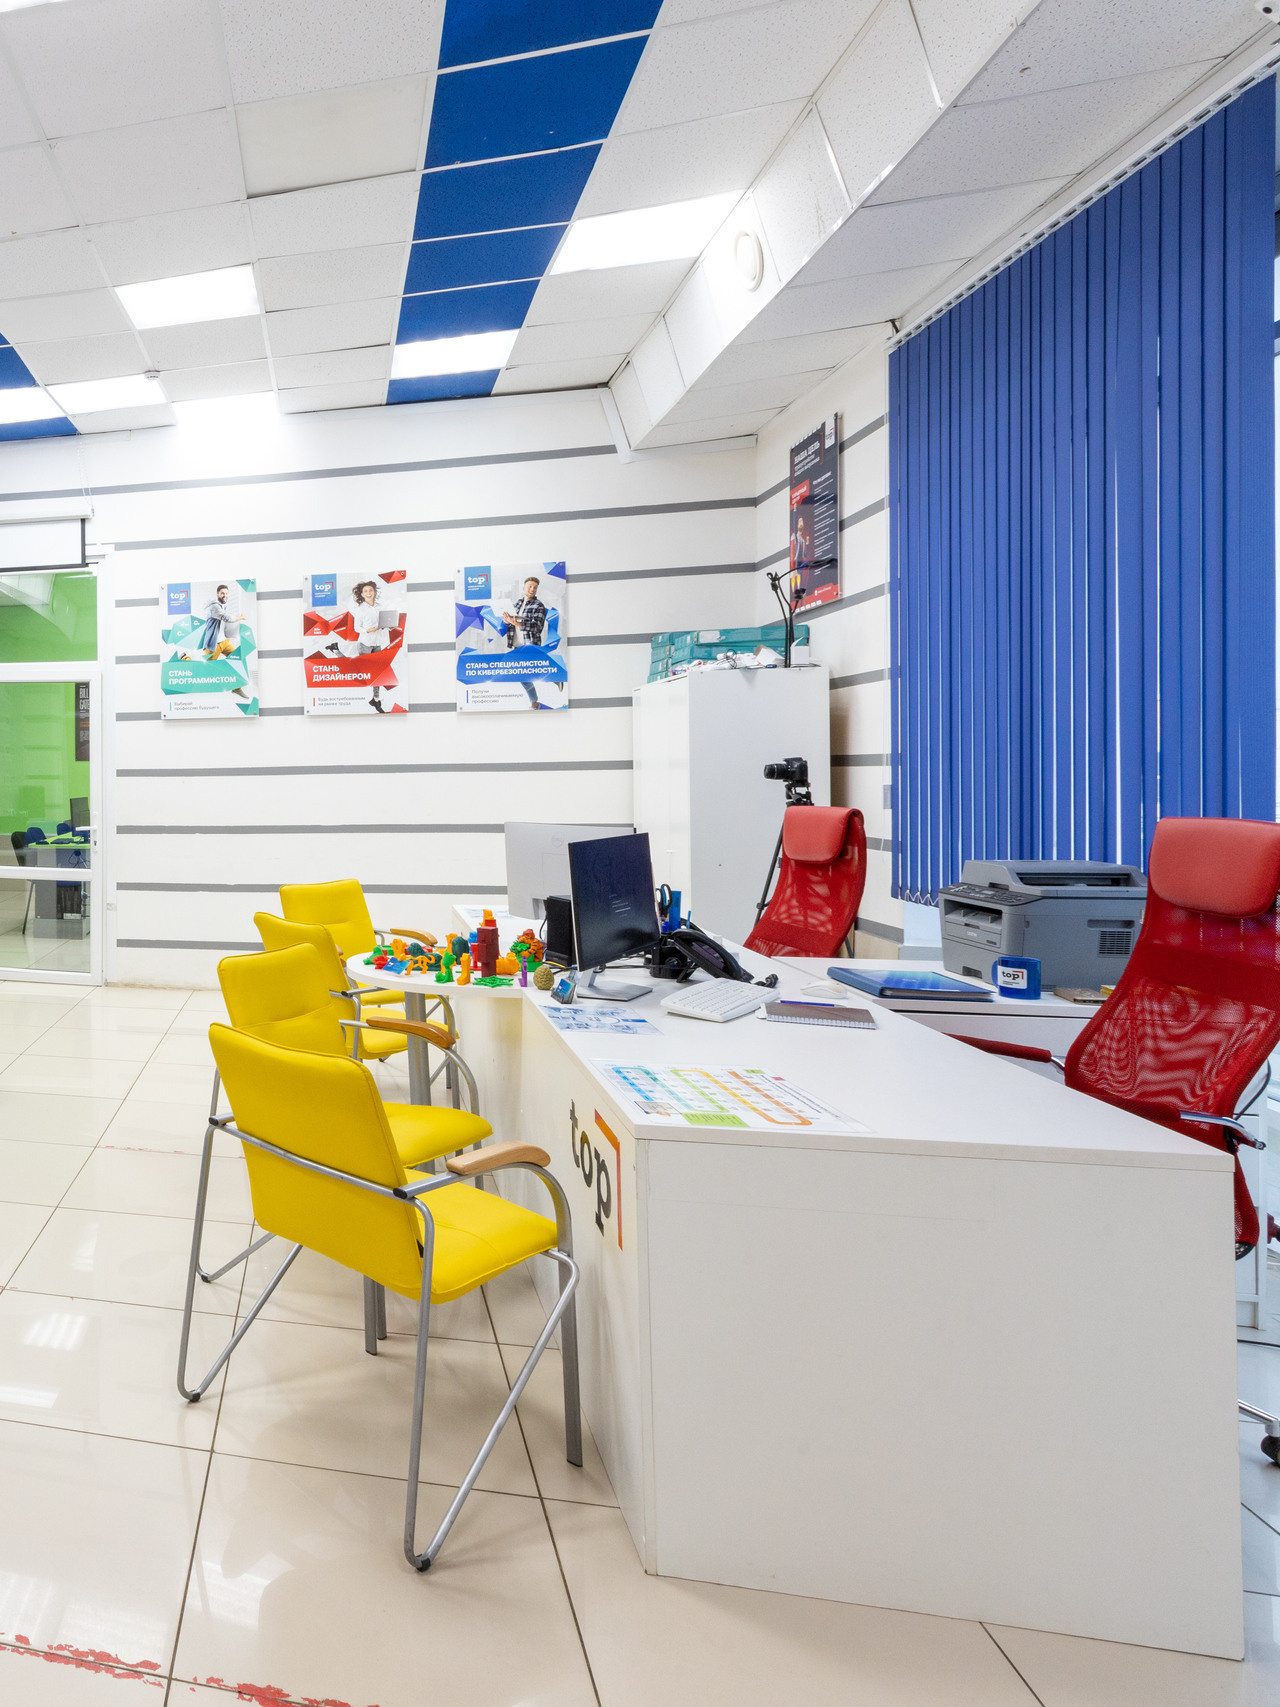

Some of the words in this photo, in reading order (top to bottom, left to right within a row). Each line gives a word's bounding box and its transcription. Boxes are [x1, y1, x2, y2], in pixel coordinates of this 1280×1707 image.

[467, 576, 485, 584] top
[314, 583, 331, 592] top
[170, 592, 186, 600] top
[490, 660, 550, 668] СПЕЦИАЛИСТОМ
[477, 667, 558, 676] КИБЕРБЕЗОПАСНОСТИ
[168, 676, 237, 685] ПРОГРАММИСТОМ
[312, 672, 371, 682] ДИЗАЙНЕРОМ
[1002, 971, 1020, 981] top
[569, 1098, 612, 1238] top
